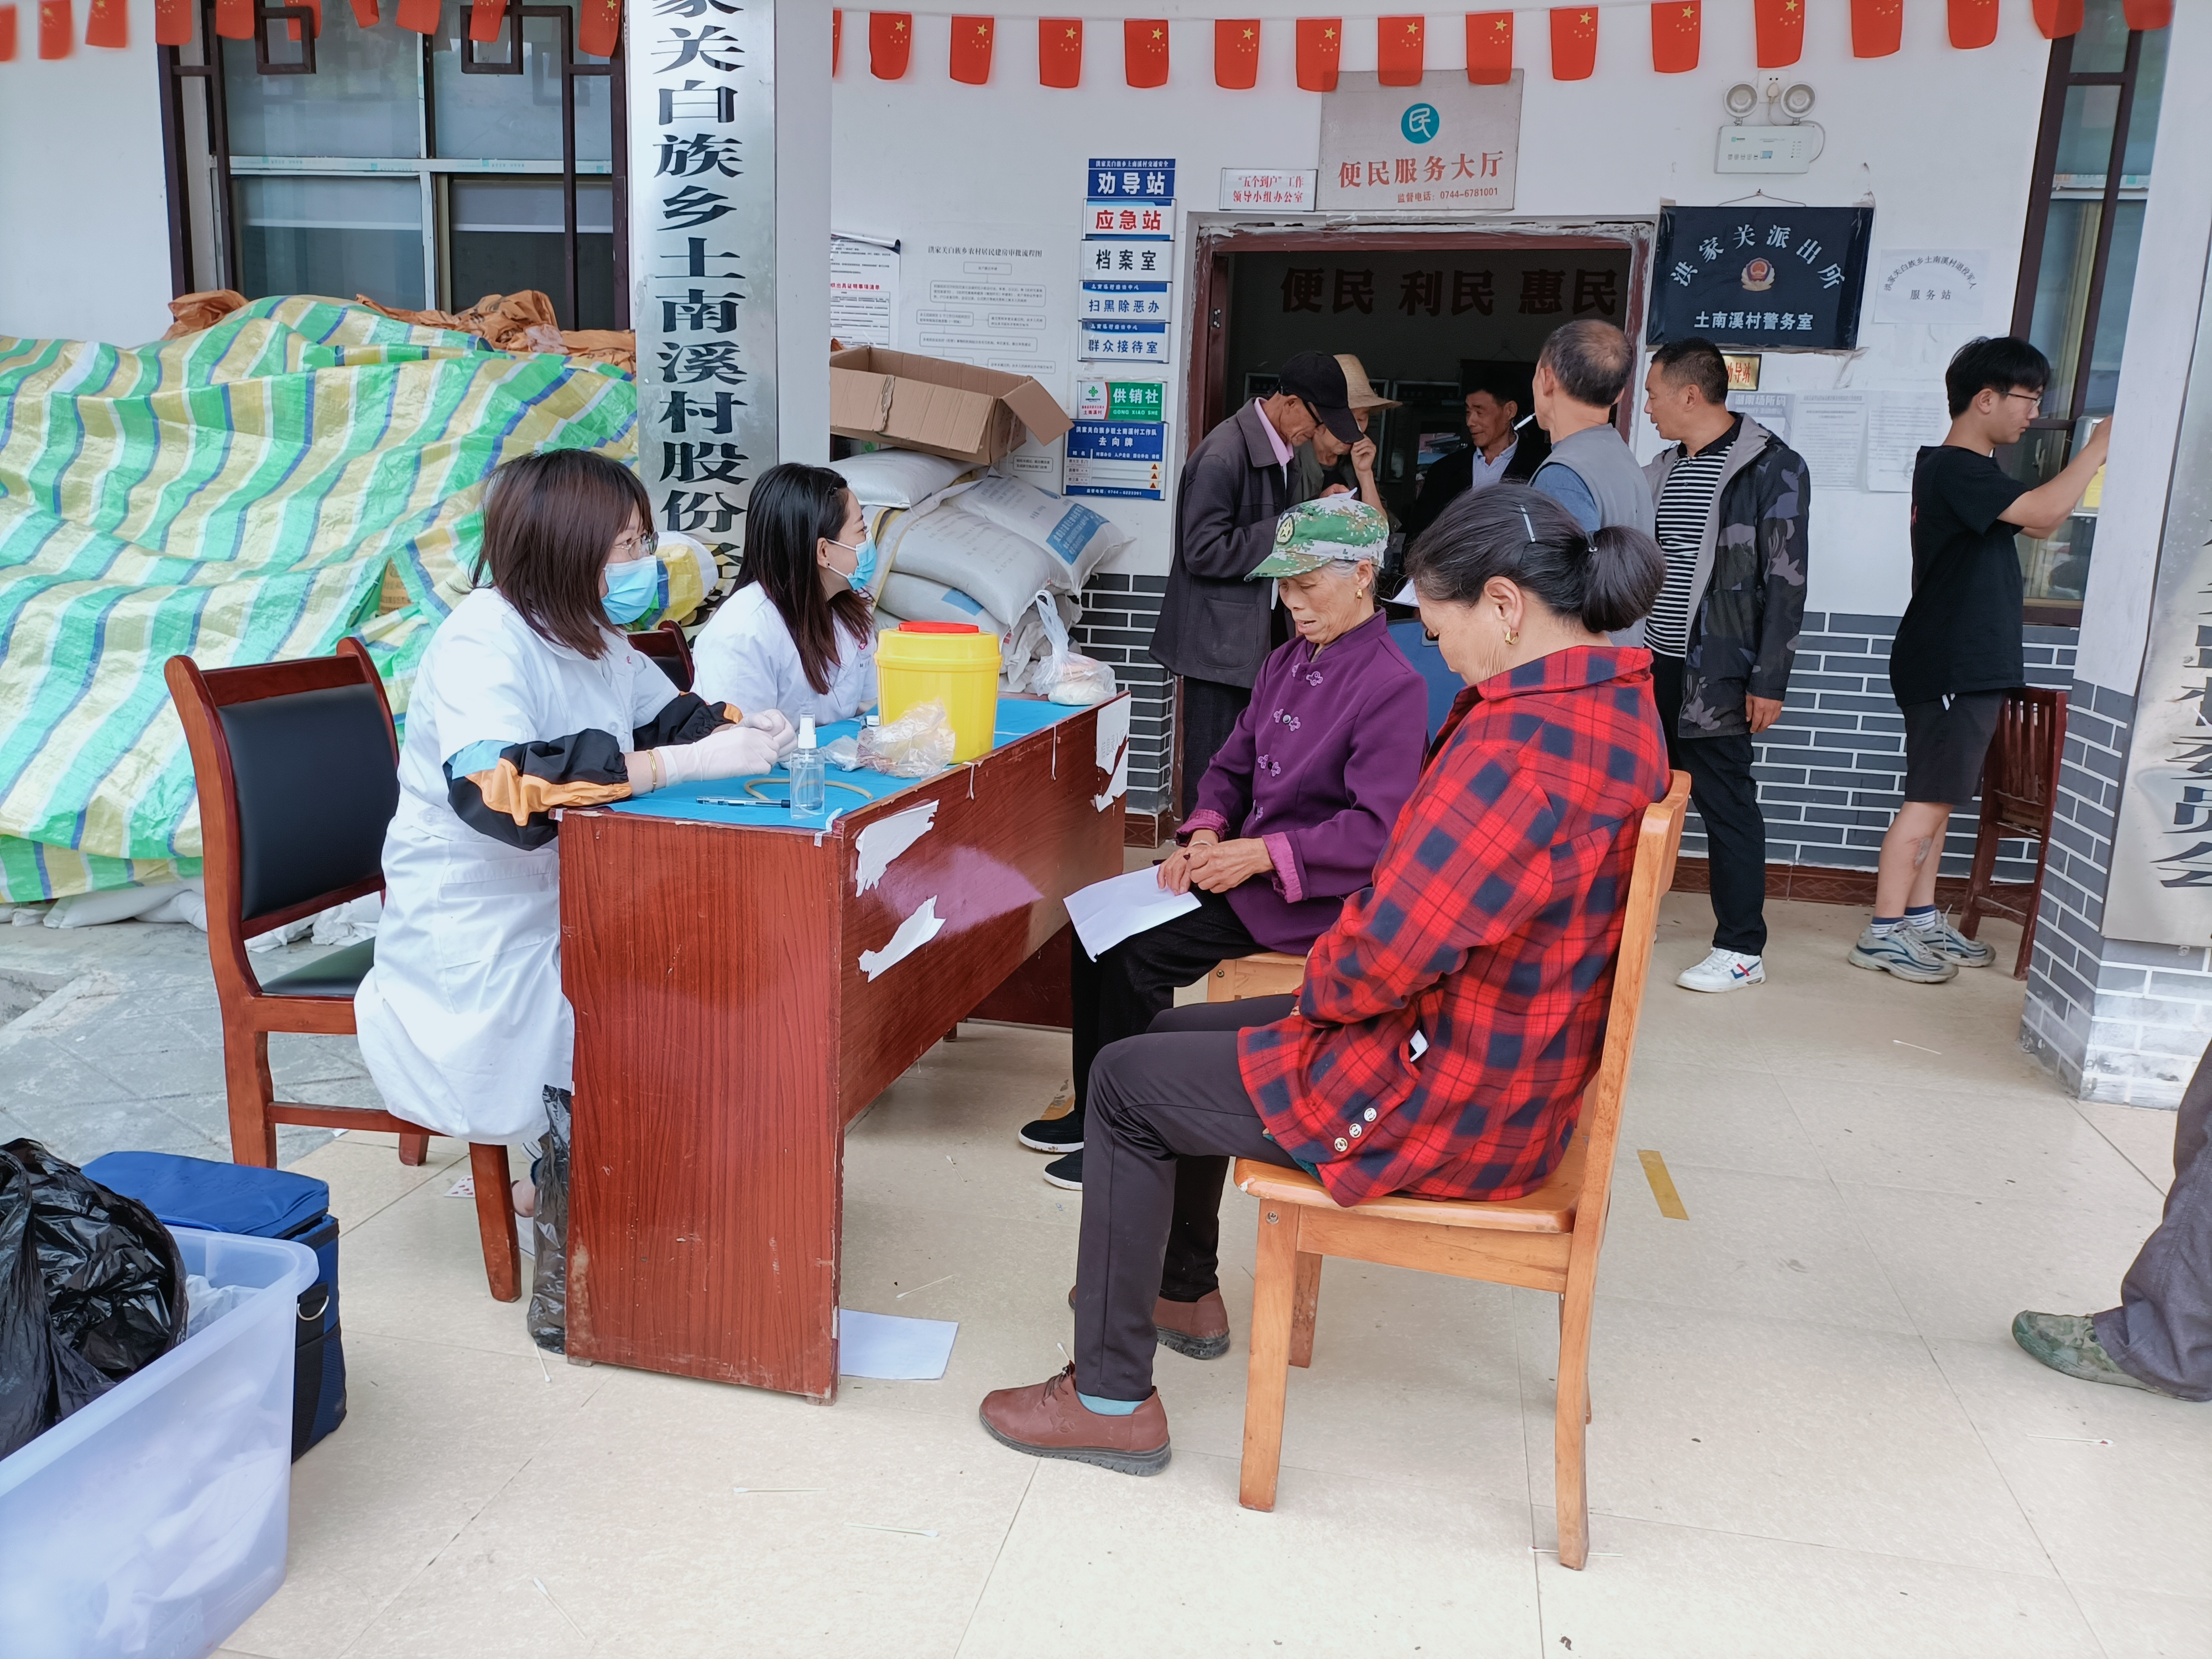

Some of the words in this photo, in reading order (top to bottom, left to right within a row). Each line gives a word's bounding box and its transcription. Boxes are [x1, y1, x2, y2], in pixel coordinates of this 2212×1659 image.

[1338, 150, 1504, 188] 便民服务大厅
[1098, 171, 1165, 195] 劝导站
[1233, 190, 1303, 203] 领导小组办公室
[1397, 190, 1436, 204] 监督电话：
[1440, 187, 1499, 200] 0744-6781001
[1095, 210, 1161, 231] 应急站
[1095, 249, 1156, 270] 档案室
[1670, 224, 1845, 289] 洪家关派出所
[1884, 255, 1977, 291] 洪家关白族乡土南溪村退役军人
[1280, 267, 1375, 314] 便民
[1397, 268, 1495, 316] 利民
[1518, 268, 1618, 315] 惠民
[1910, 289, 1952, 300] 服务站
[1089, 299, 1160, 313] 扫黑除恶办
[1694, 311, 1814, 330] 土南溪村警务室
[1088, 340, 1158, 354] 群众接待室
[1113, 388, 1159, 404] 供销社
[1735, 394, 1786, 406] 湖南场所码
[1098, 436, 1133, 447] 去向牌
